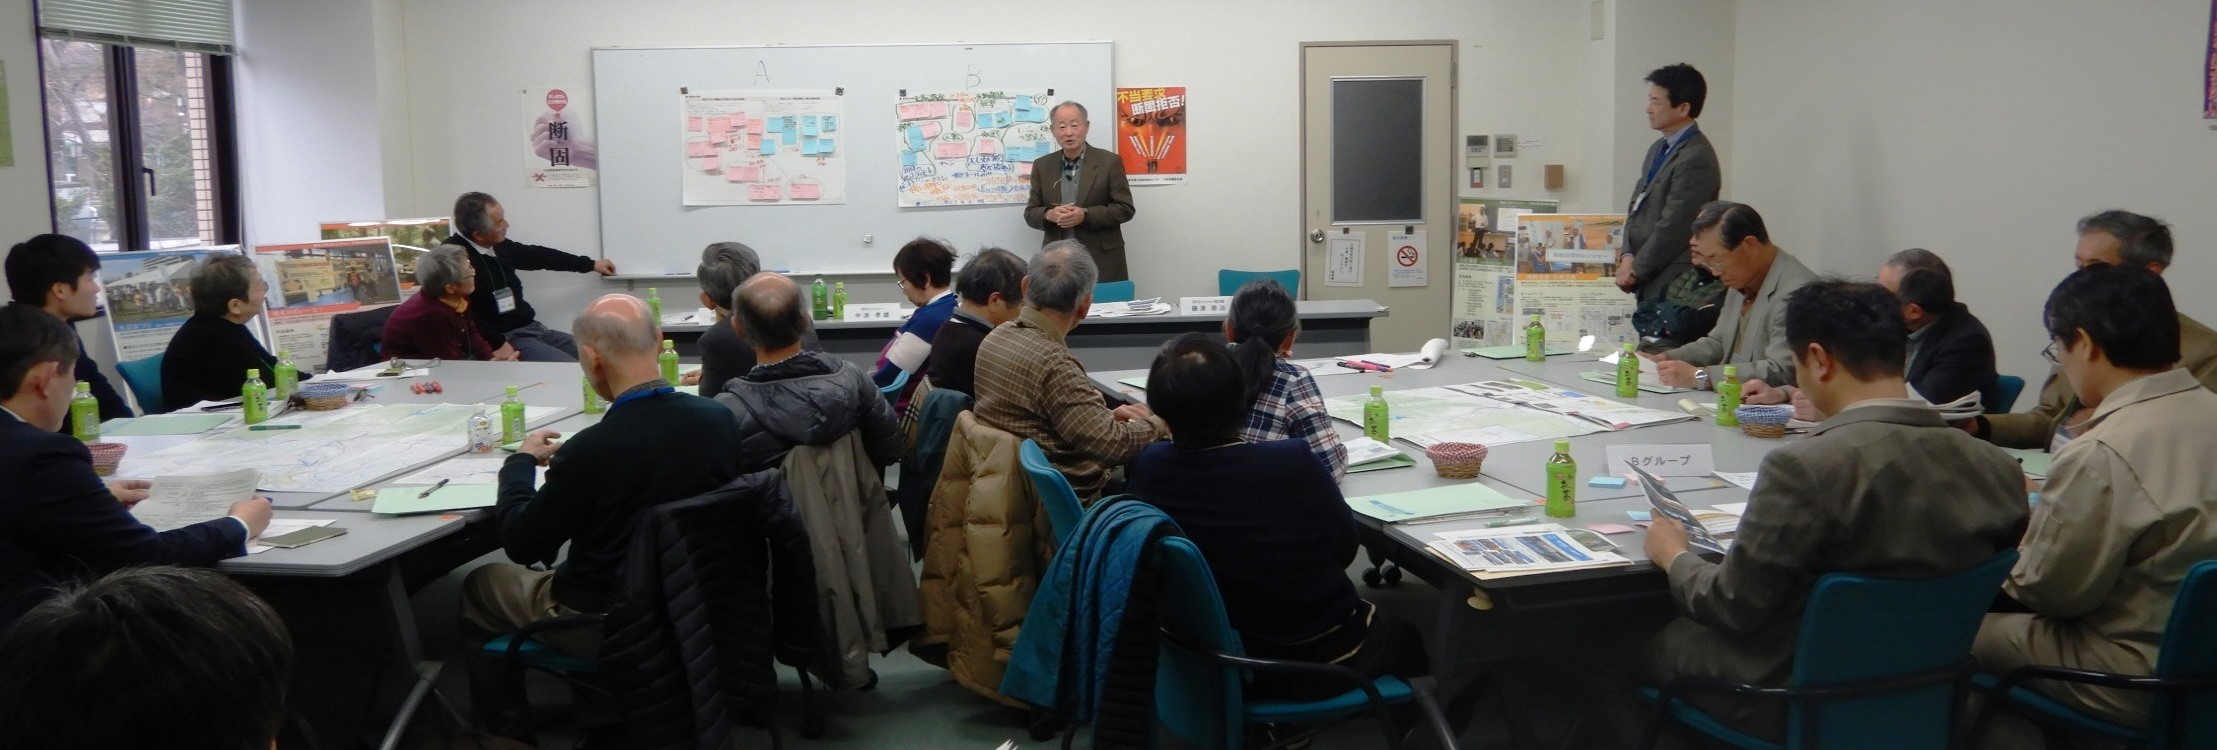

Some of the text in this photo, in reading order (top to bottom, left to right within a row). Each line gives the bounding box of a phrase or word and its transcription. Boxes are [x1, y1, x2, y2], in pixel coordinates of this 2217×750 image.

[754, 60, 770, 87] A
[966, 64, 982, 90] B
[1117, 88, 1166, 104] 不当要求
[548, 121, 569, 167] 断固
[1631, 454, 1692, 467] Bグループ
